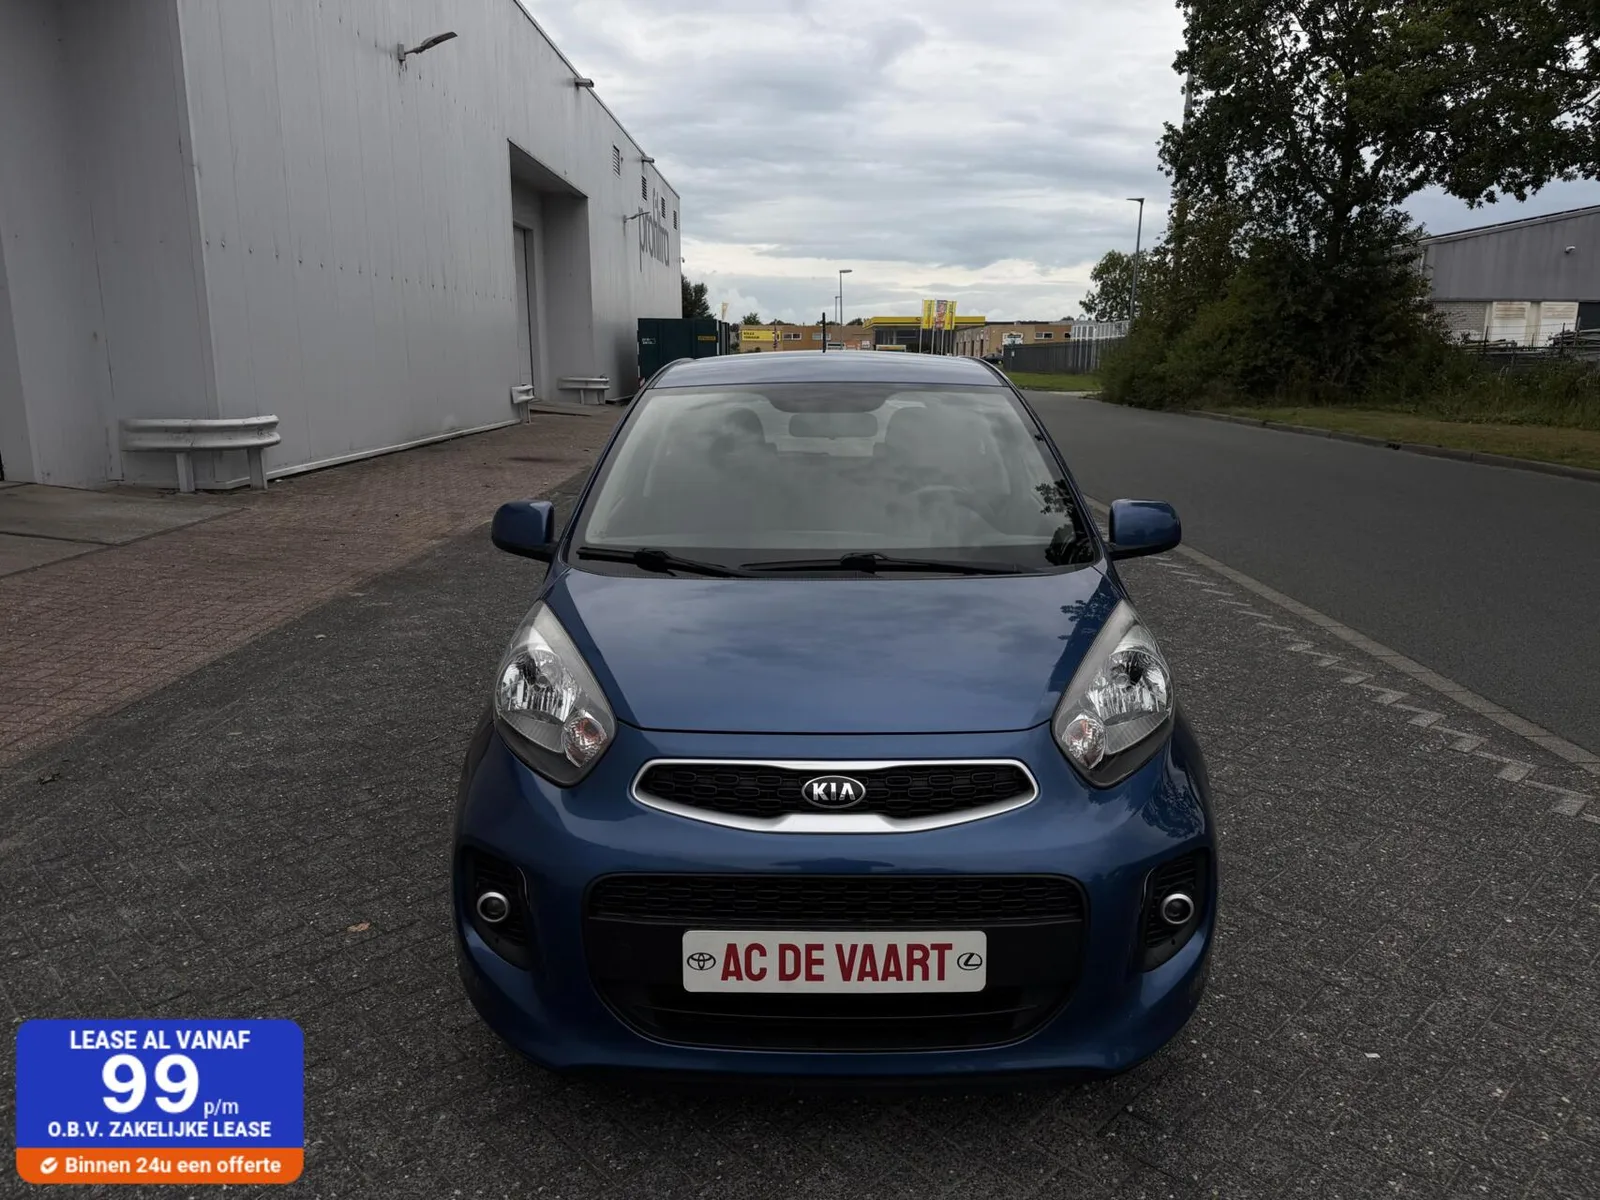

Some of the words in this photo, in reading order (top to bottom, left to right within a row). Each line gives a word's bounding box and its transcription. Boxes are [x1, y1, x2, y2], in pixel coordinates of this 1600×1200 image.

[812, 782, 855, 801] KIA
[721, 943, 768, 982] AC
[778, 943, 825, 982] DE
[835, 943, 953, 982] VAART
